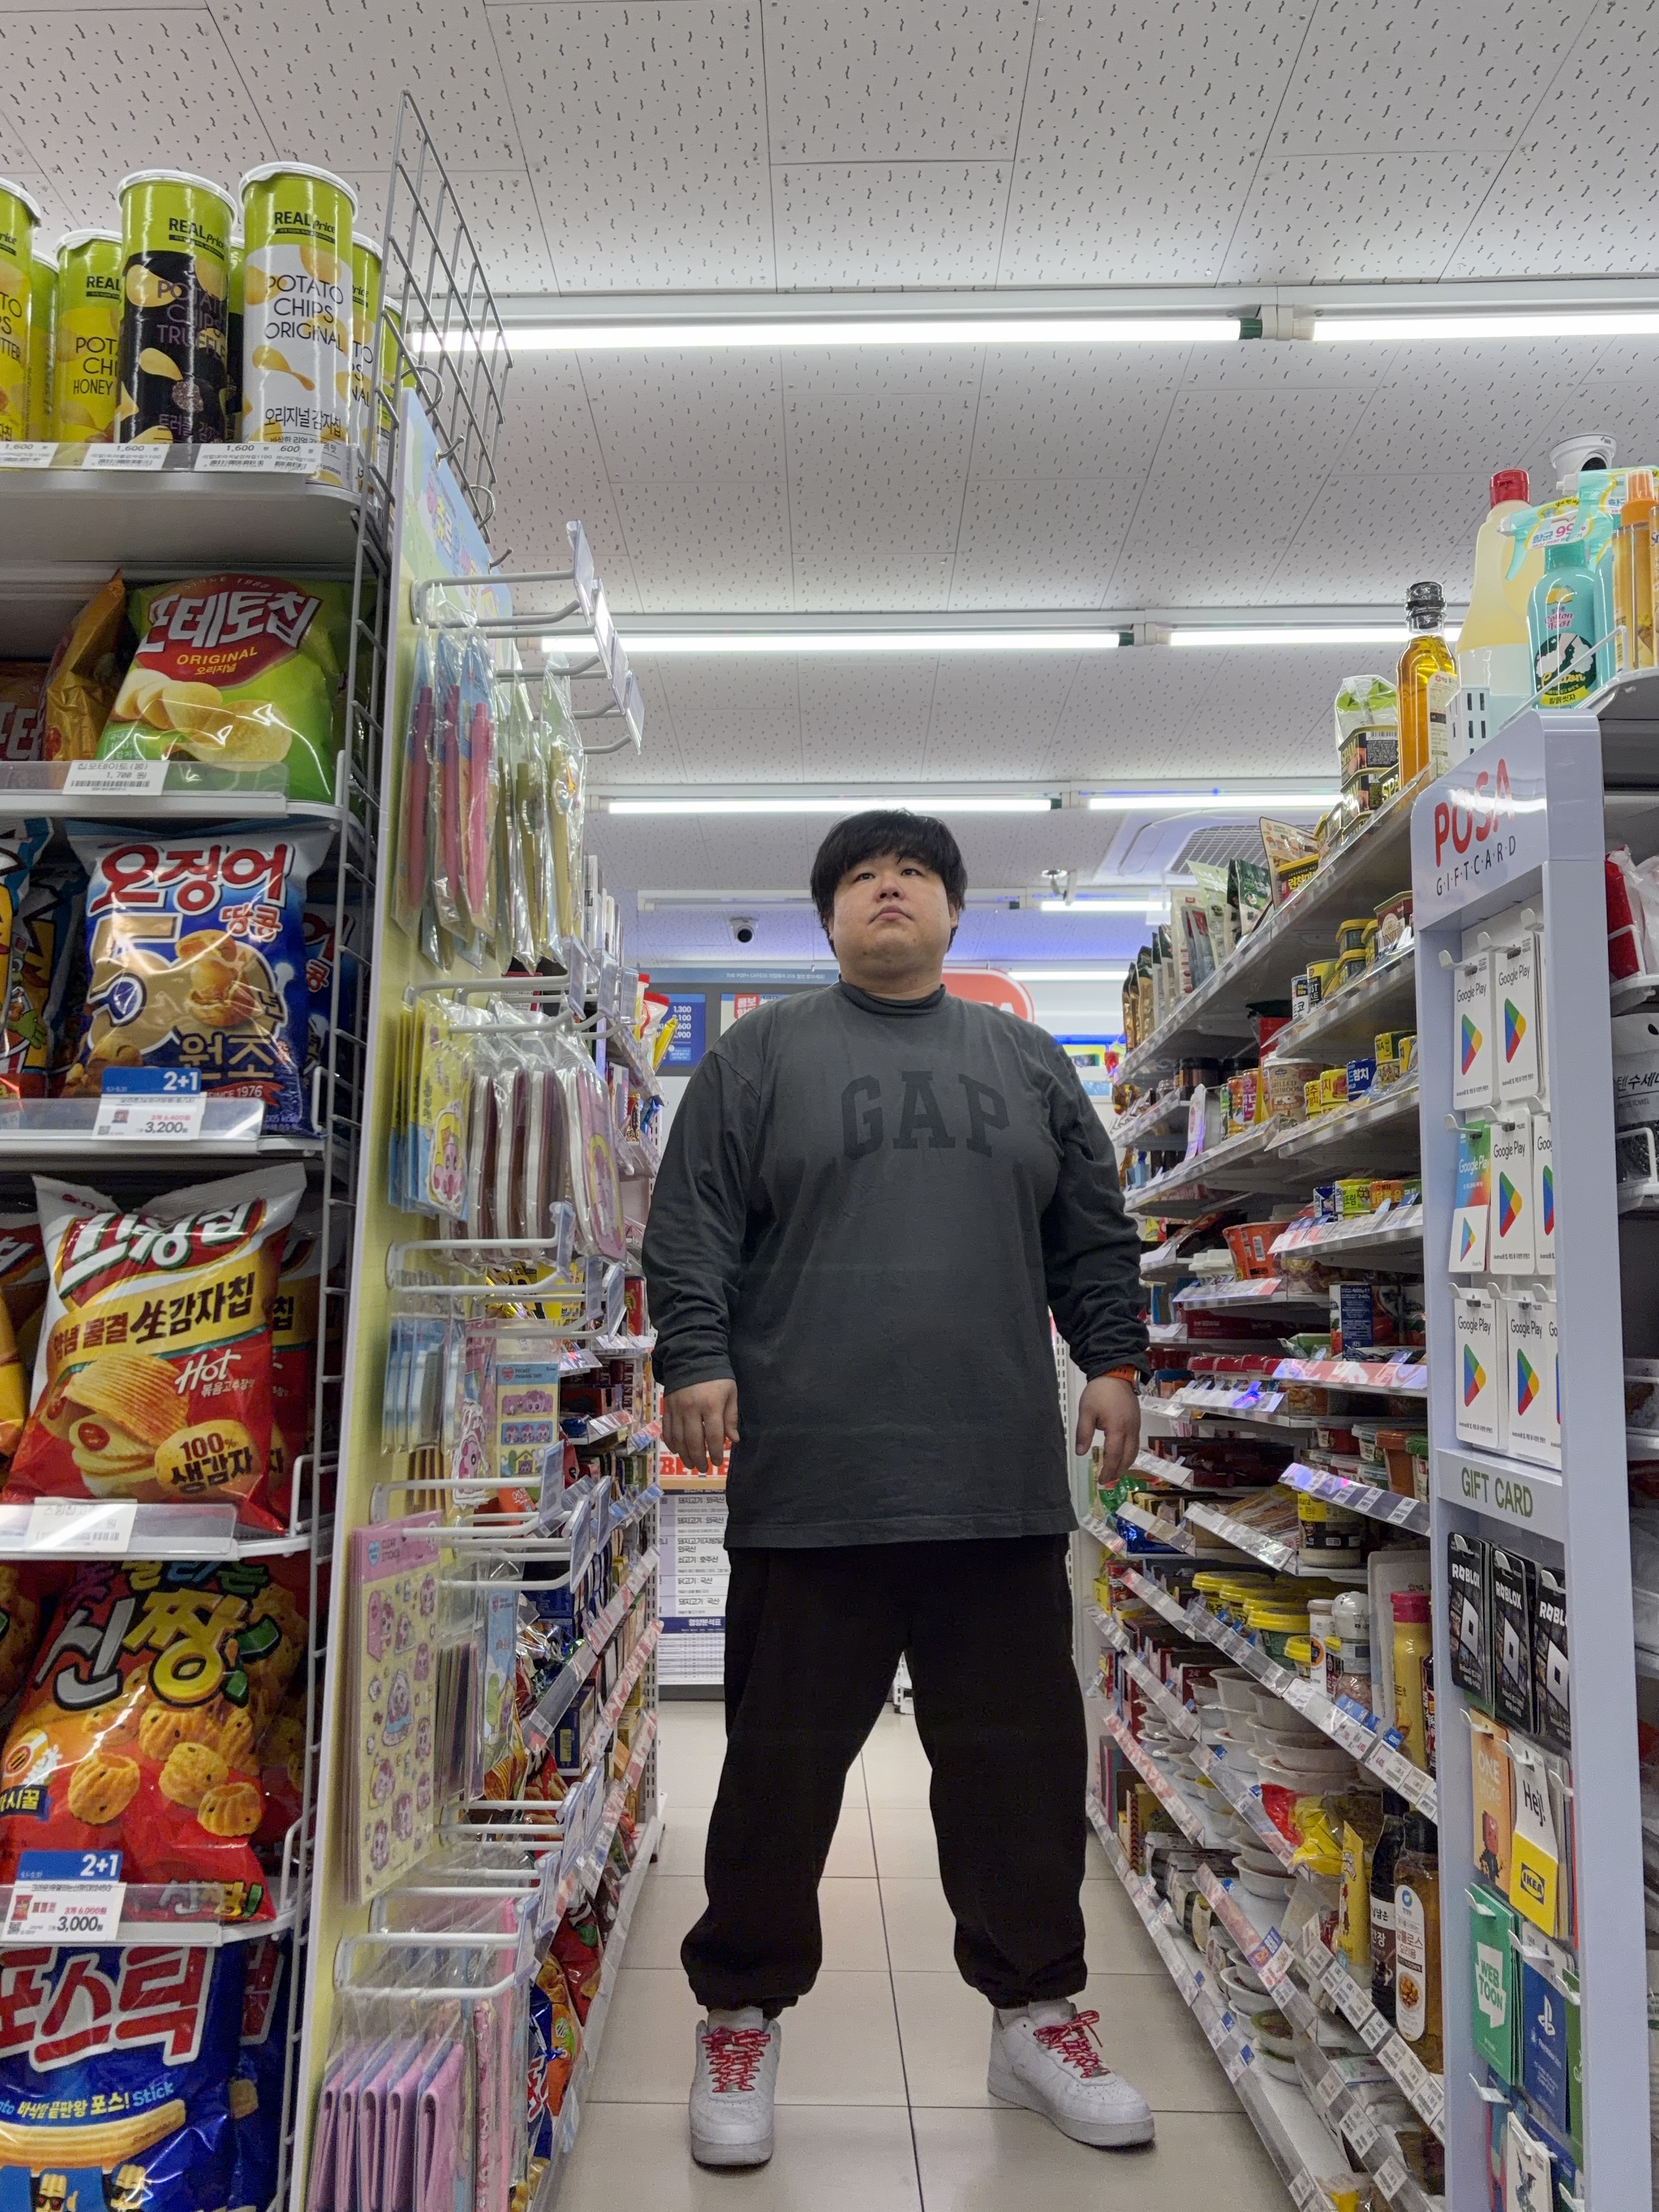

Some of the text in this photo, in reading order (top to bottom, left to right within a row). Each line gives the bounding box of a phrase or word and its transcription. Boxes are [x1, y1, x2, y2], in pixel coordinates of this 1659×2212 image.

[169, 217, 205, 240] REAL
[274, 212, 310, 227] REAL
[87, 276, 121, 292] REAL
[268, 274, 344, 305] POTATO
[158, 280, 223, 315] POTAT
[274, 297, 334, 324] CHIPS
[76, 336, 118, 354] POT
[264, 321, 344, 353] ORIGINAL
[73, 379, 113, 396] HONEY
[265, 405, 342, 438] 오리지널 감자칩
[1544, 613, 1574, 624] Cotton
[177, 646, 258, 665] ORIGINAL
[195, 663, 236, 675] 오리지널
[1382, 774, 1400, 802] SPA
[1434, 758, 1516, 868] POSA
[89, 844, 289, 915] 오징어
[220, 903, 281, 942] 땅콩
[1499, 964, 1531, 986] Google Play
[1456, 982, 1487, 1002] Google Play
[163, 1071, 199, 1091] 2+1
[237, 1085, 263, 1098] 1976
[841, 1070, 1010, 1159] GAP
[145, 1122, 183, 1133] 3,200
[1494, 1140, 1525, 1160] Google Play
[1537, 1135, 1552, 1152] Goo
[1458, 1158, 1479, 1175] Google
[1458, 1315, 1491, 1335] Google Play
[1510, 1318, 1531, 1338] Google
[1531, 1320, 1542, 1339] Play
[174, 1348, 242, 1395] Hot
[180, 1432, 237, 1462] 100%
[171, 1446, 253, 1494] 생감자
[1461, 1466, 1533, 1518] GIFT CARD
[1452, 1563, 1481, 1589] ROBLOX
[1496, 1580, 1522, 1610] ROBLOX
[1539, 1600, 1567, 1627] ROBL
[1522, 1780, 1546, 1828] Hej!
[79, 1853, 119, 1877] 2+1
[1523, 1871, 1544, 1895] IKEA
[57, 1916, 98, 1932] 3,000
[90, 2091, 130, 2116] 포스!
[132, 2081, 175, 2107] Stick
